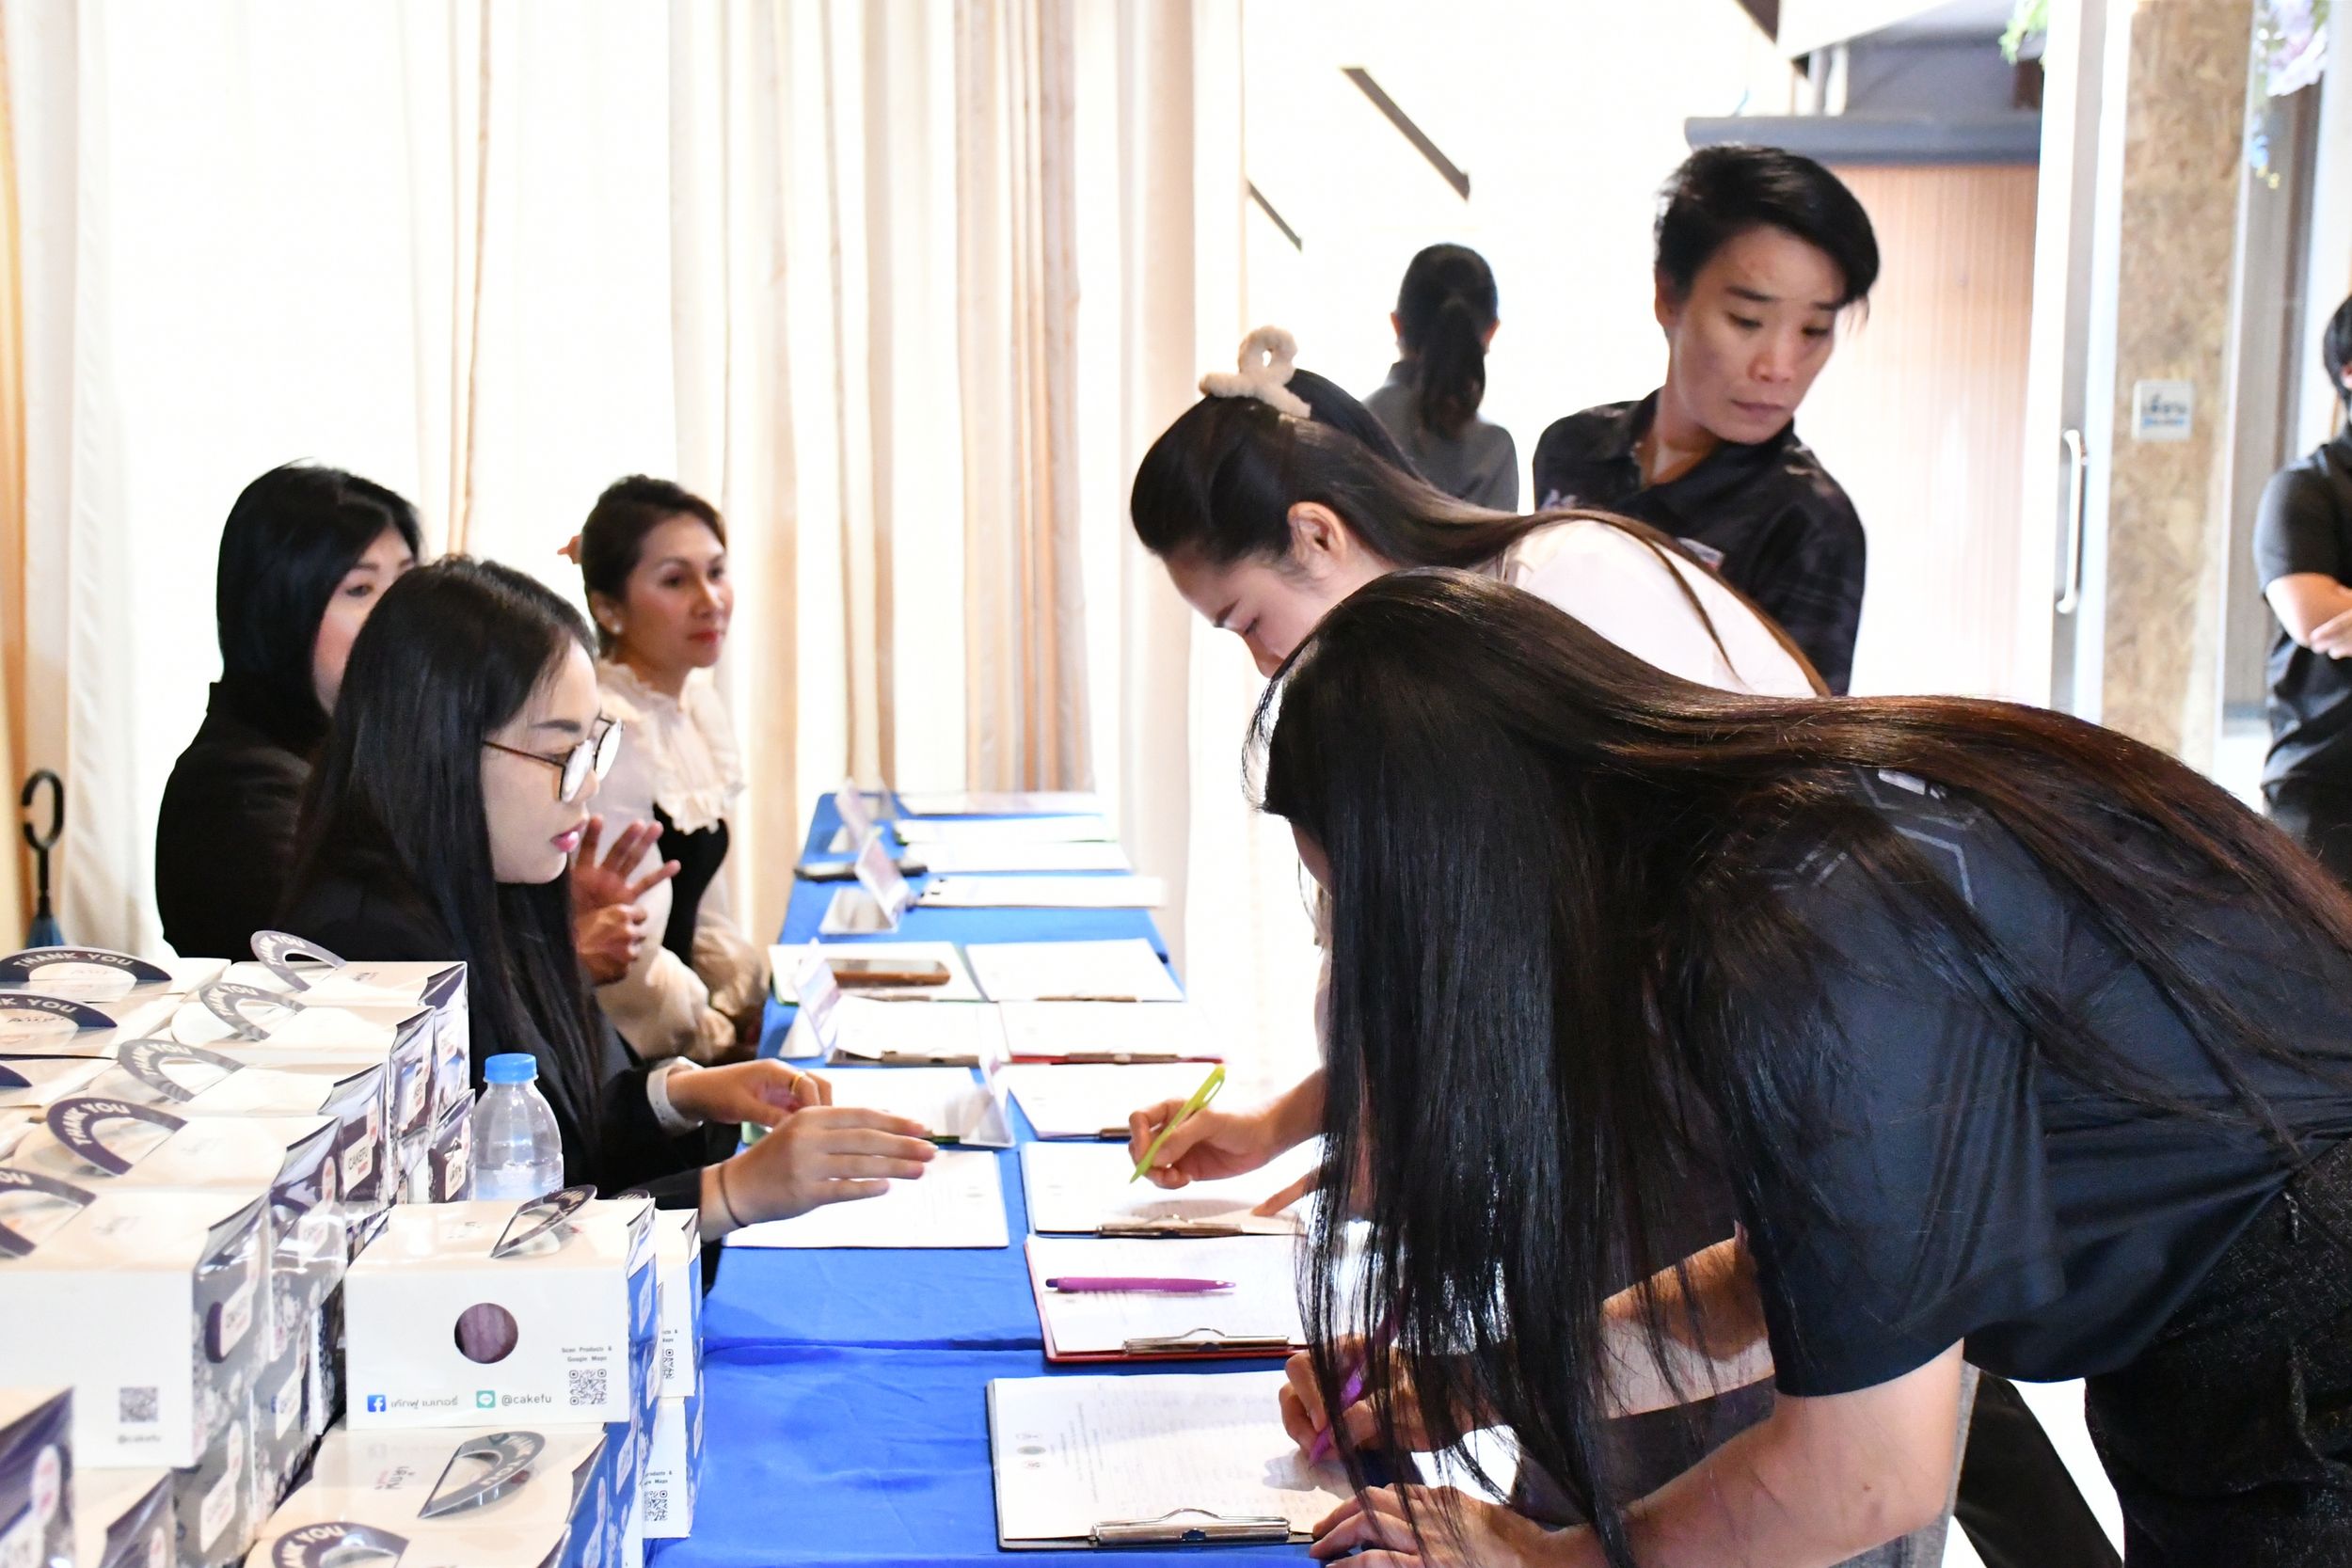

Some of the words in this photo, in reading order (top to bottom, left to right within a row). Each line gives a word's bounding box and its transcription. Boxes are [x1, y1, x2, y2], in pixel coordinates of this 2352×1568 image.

[270, 934, 307, 949] YOU
[12, 952, 78, 968] THANK
[87, 952, 135, 967] YOU
[221, 985, 260, 997] YOU
[26, 997, 78, 1014] YOU
[131, 1045, 159, 1076] THANK
[149, 1043, 194, 1055] YOU
[62, 1106, 93, 1146] THANK
[80, 1101, 132, 1116] YOU
[0, 1170, 33, 1186] OU
[501, 1393, 552, 1407] @cakefu
[294, 1524, 347, 1544] YOU
